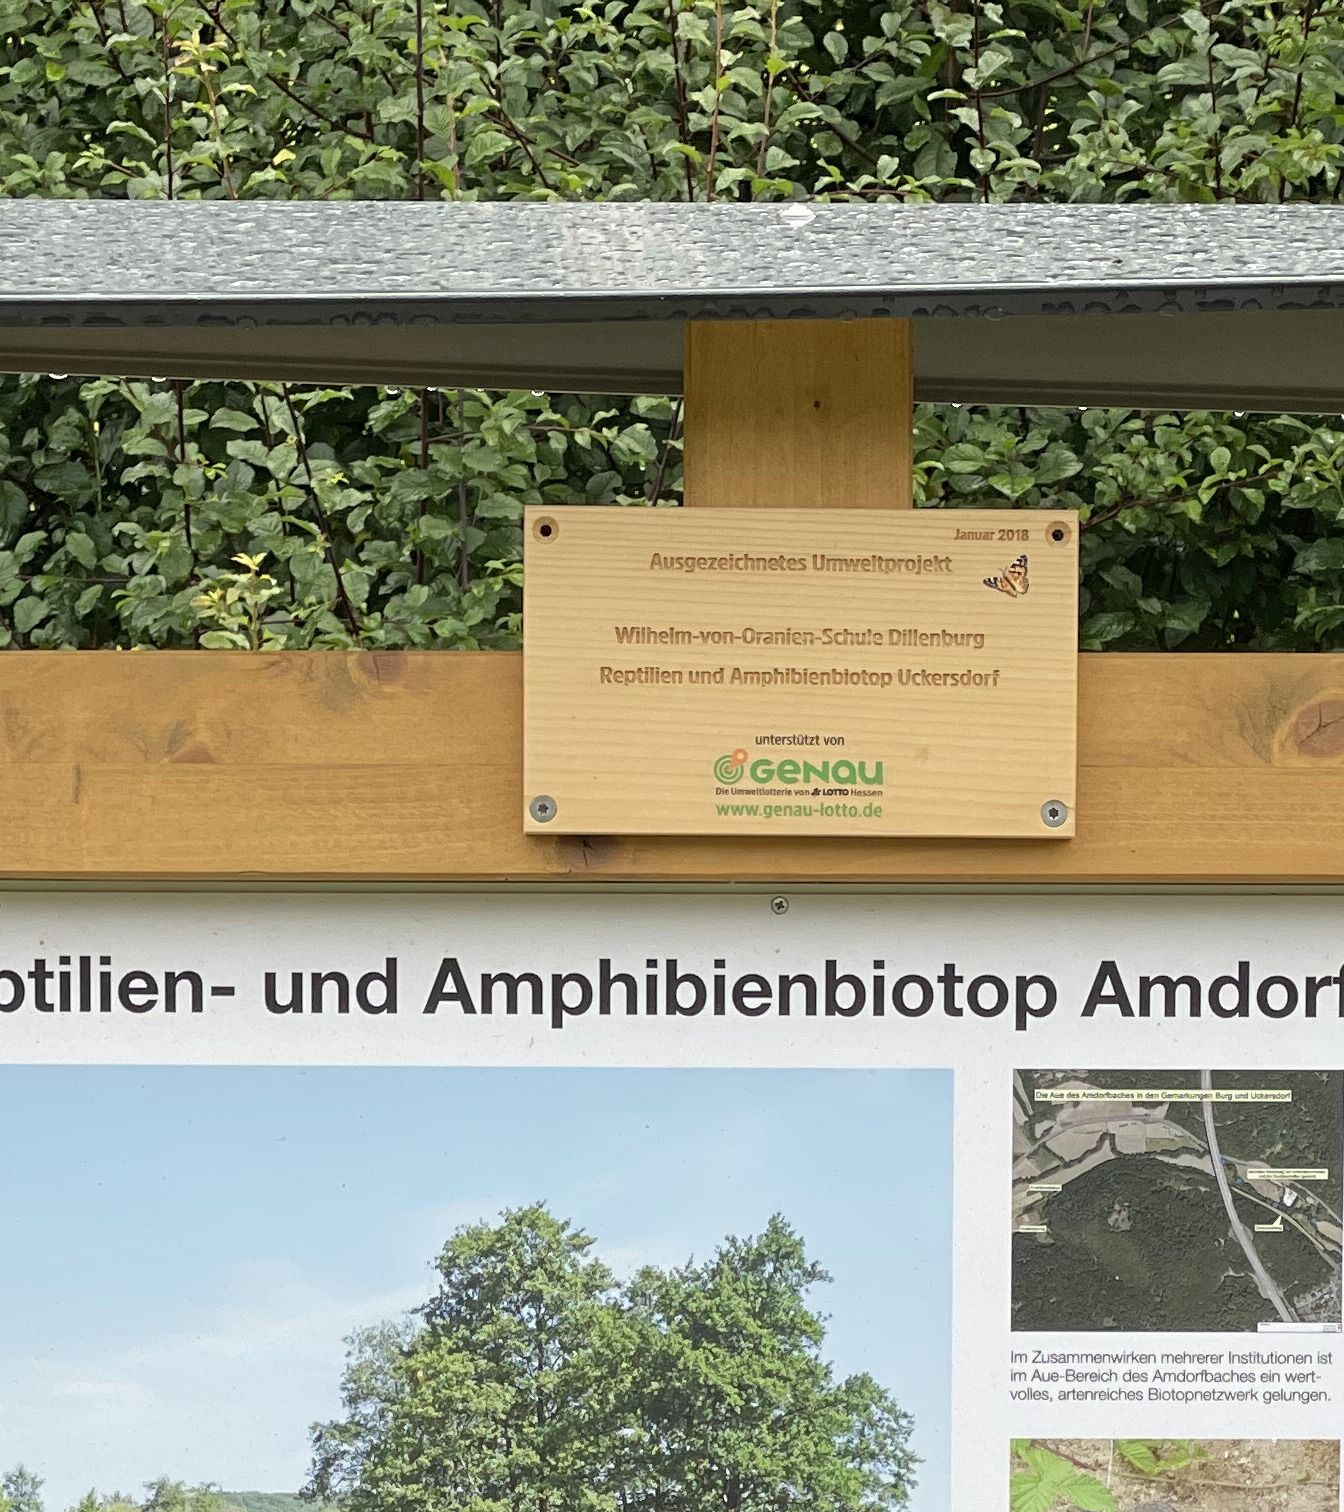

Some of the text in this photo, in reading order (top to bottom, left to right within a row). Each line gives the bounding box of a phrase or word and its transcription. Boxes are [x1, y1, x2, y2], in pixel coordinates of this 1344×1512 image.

[953, 528, 1030, 543] Januar 2018
[649, 552, 953, 575] Ausgezeichnetes Umweltprojekt
[614, 626, 985, 649] Wilhelm-von-Oranien-Schule Dillenburg
[600, 666, 1000, 688] Reptilien und Amphibienbiotop Uckersdorf
[755, 733, 845, 746] unterstützt von
[715, 787, 883, 798] Die Umweltlotterie von LOTTO Hessen
[715, 801, 883, 818] www.genau-lotto.de
[263, 955, 398, 1015] und
[422, 949, 1058, 1032] Amphibienbiotop
[1010, 1349, 1334, 1366] Im Zusammenwirken mehrerer Institutionen ist
[1010, 1368, 1322, 1384] im Aue-Bereich des Amdorfbaches ein wert-
[1008, 1386, 1332, 1406] volles, artenreiches Biotopnetzwerk gelungen.
